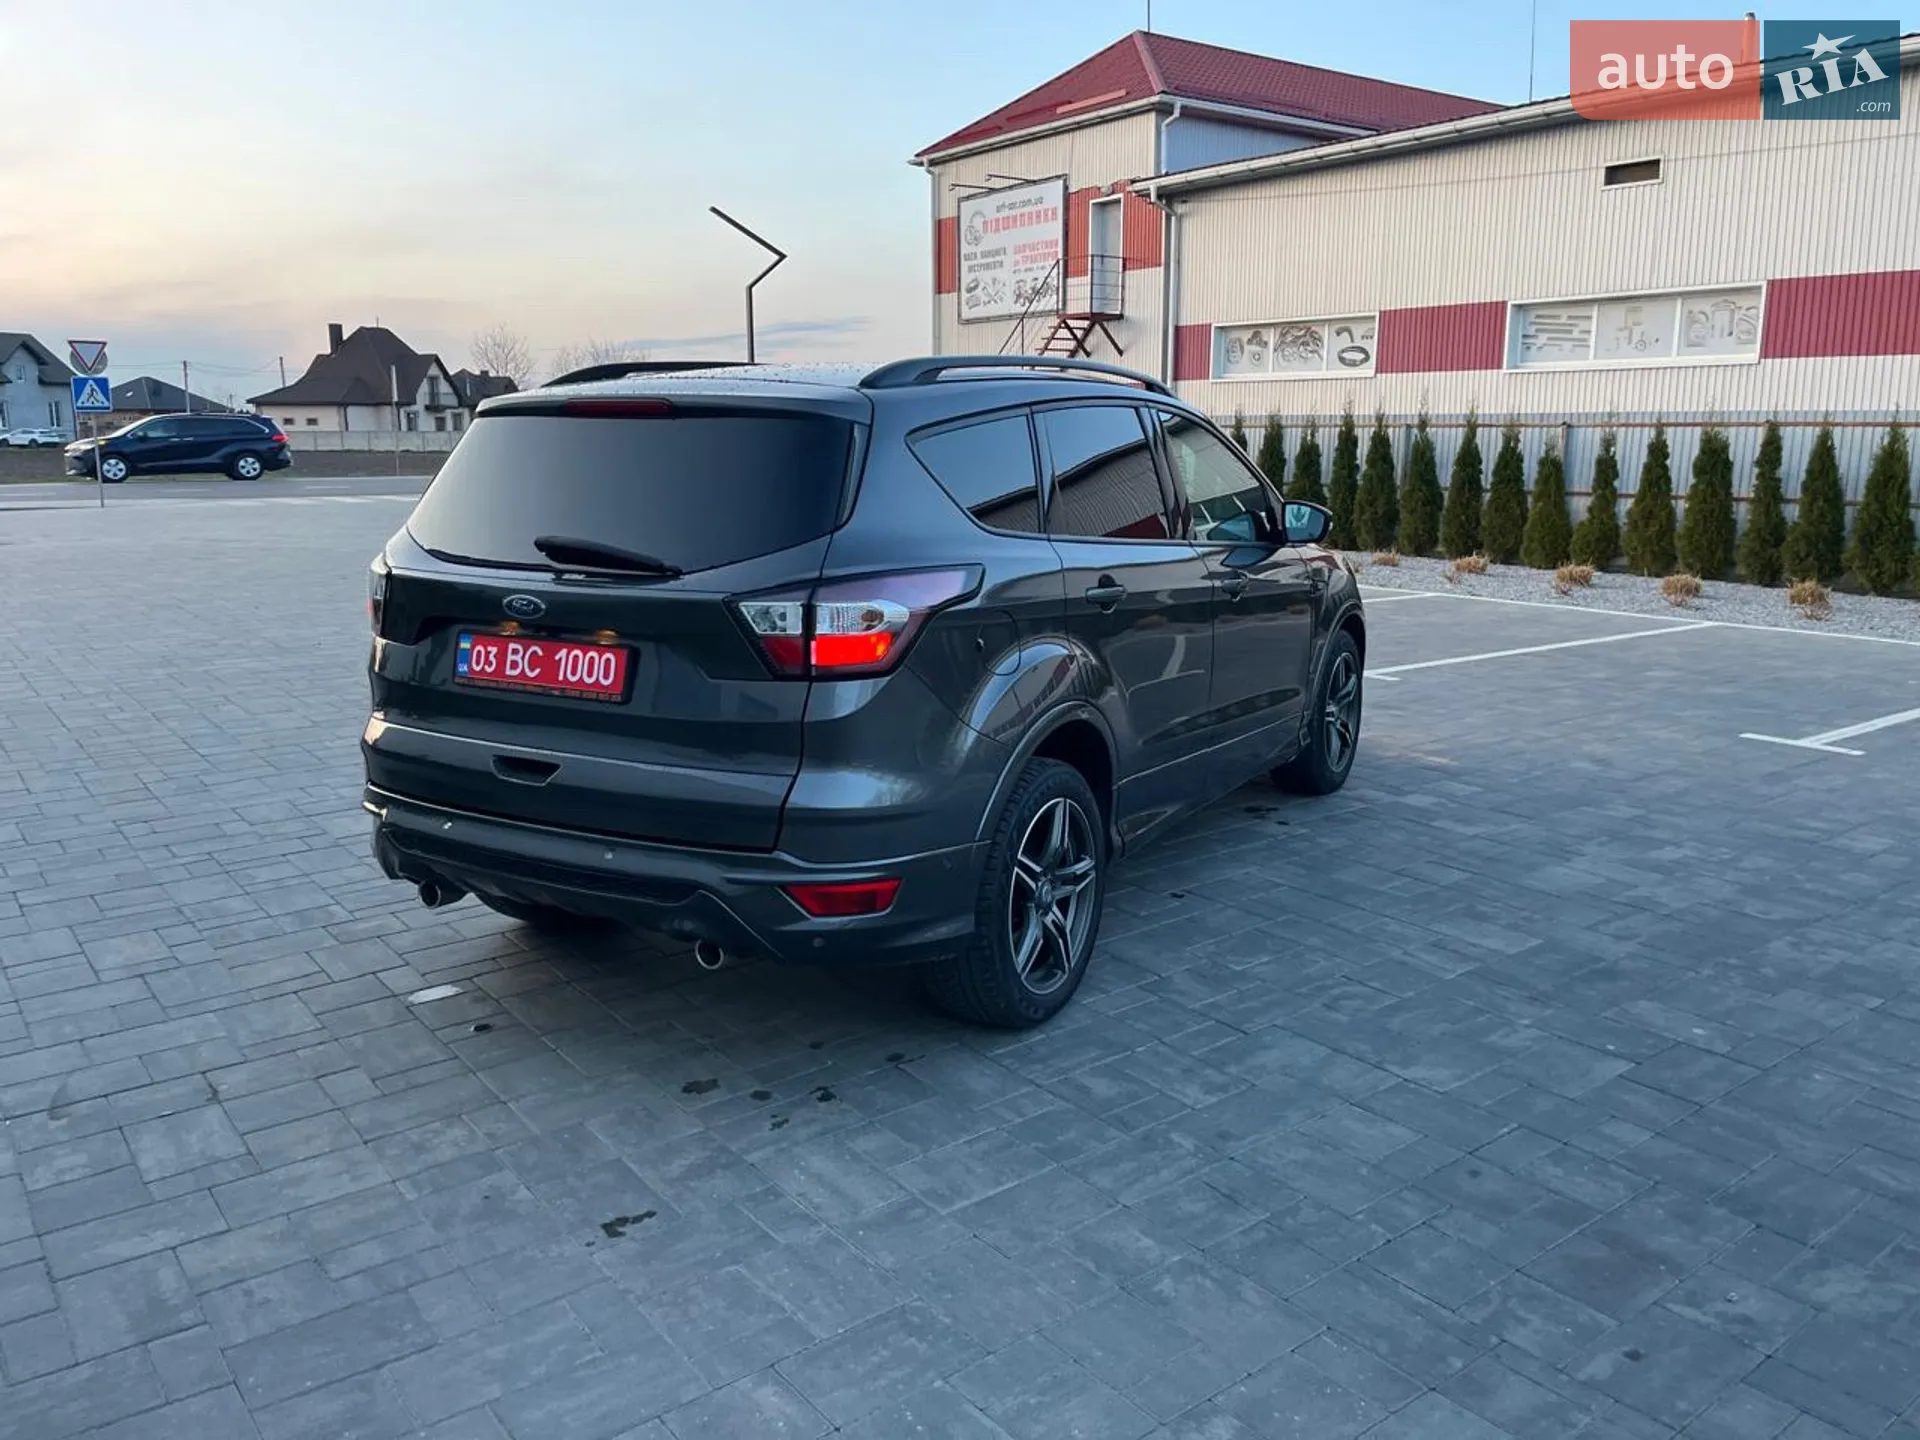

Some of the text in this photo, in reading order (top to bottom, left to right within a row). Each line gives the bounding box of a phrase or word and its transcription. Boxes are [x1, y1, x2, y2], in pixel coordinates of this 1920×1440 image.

[471, 642, 617, 686] 03 BC 1000
